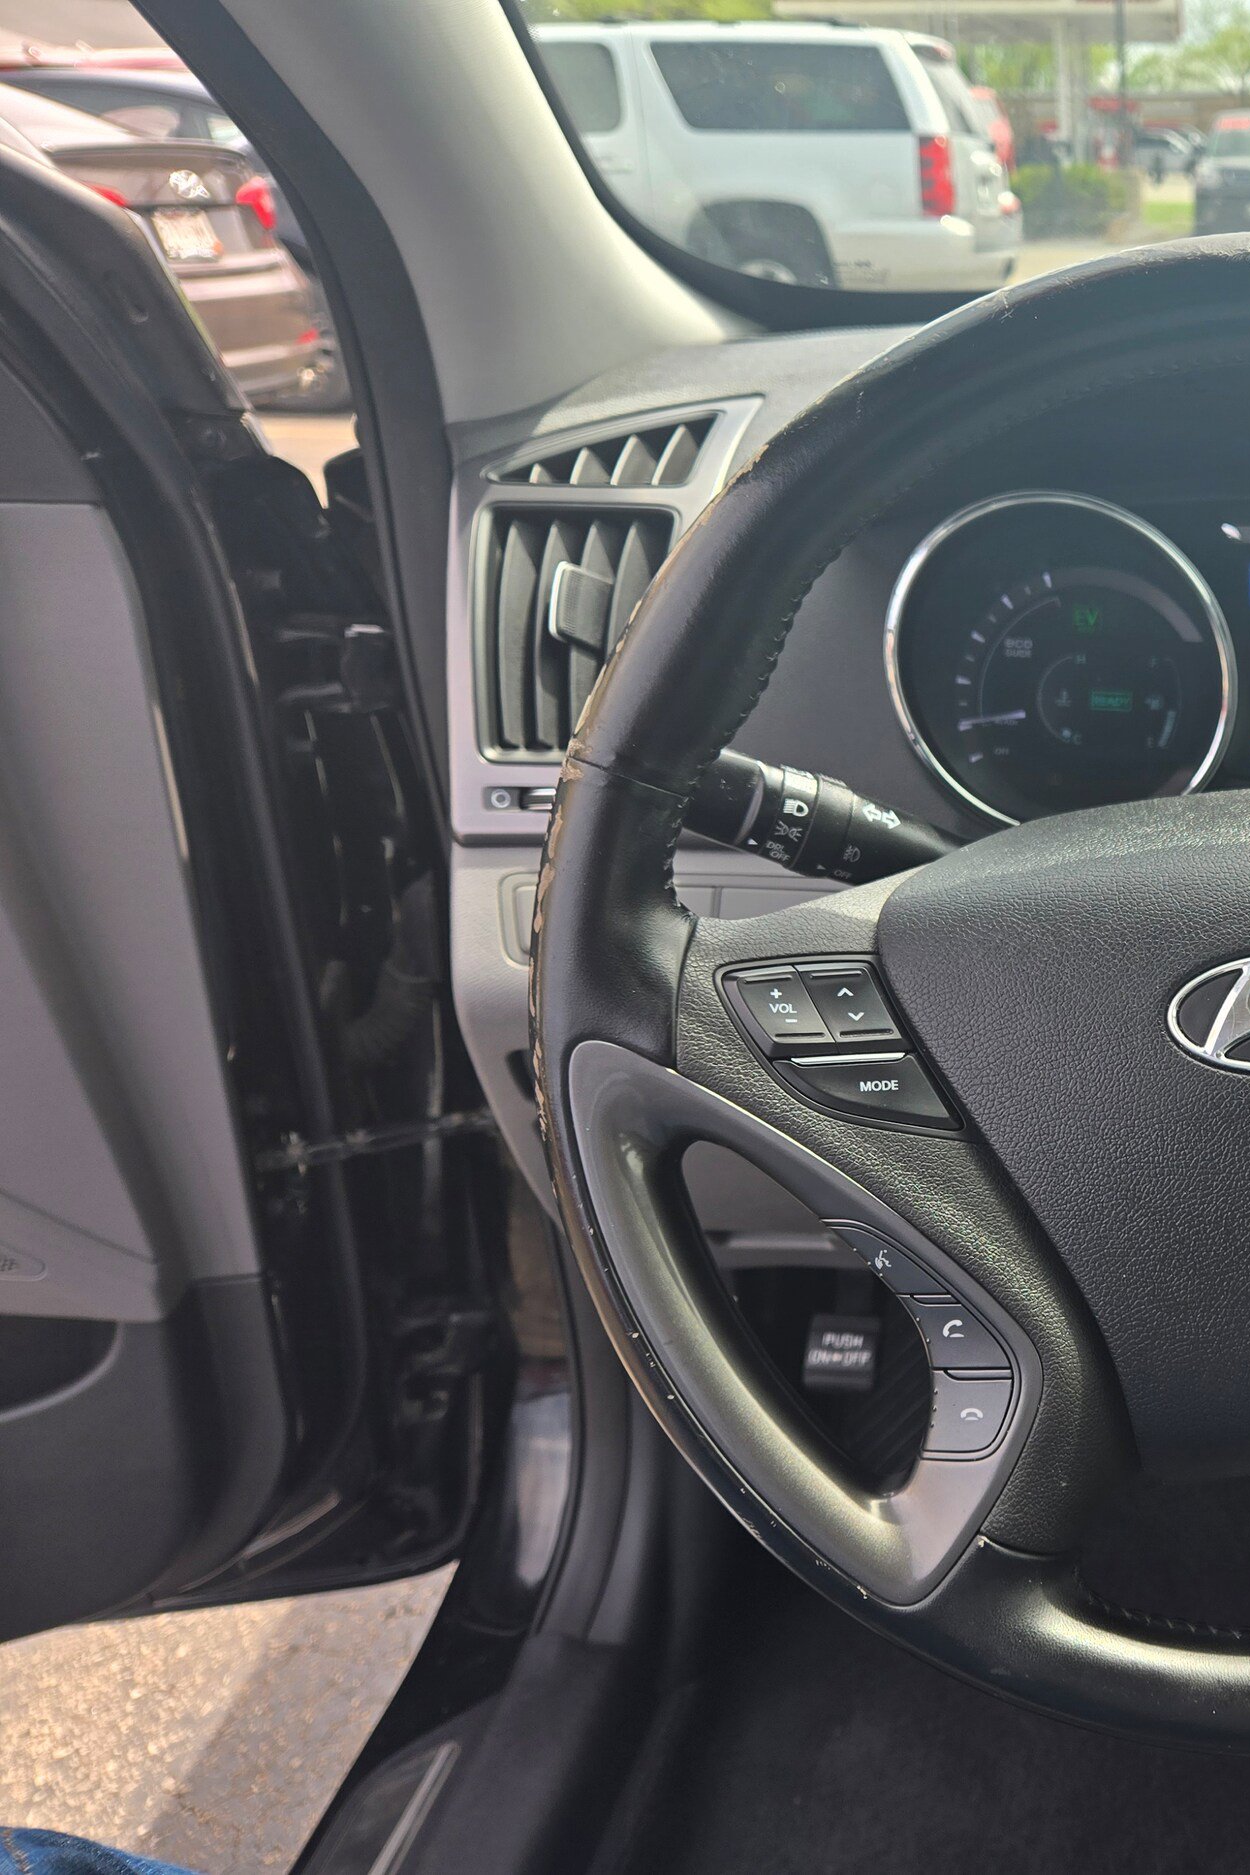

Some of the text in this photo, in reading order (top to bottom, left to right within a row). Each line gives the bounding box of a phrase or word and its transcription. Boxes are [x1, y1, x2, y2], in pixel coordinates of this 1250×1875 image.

[770, 850, 790, 862] OFF
[833, 868, 851, 880] OFF
[769, 1003, 797, 1014] VOL
[860, 1080, 899, 1092] MODE
[822, 1332, 865, 1349] PUSH
